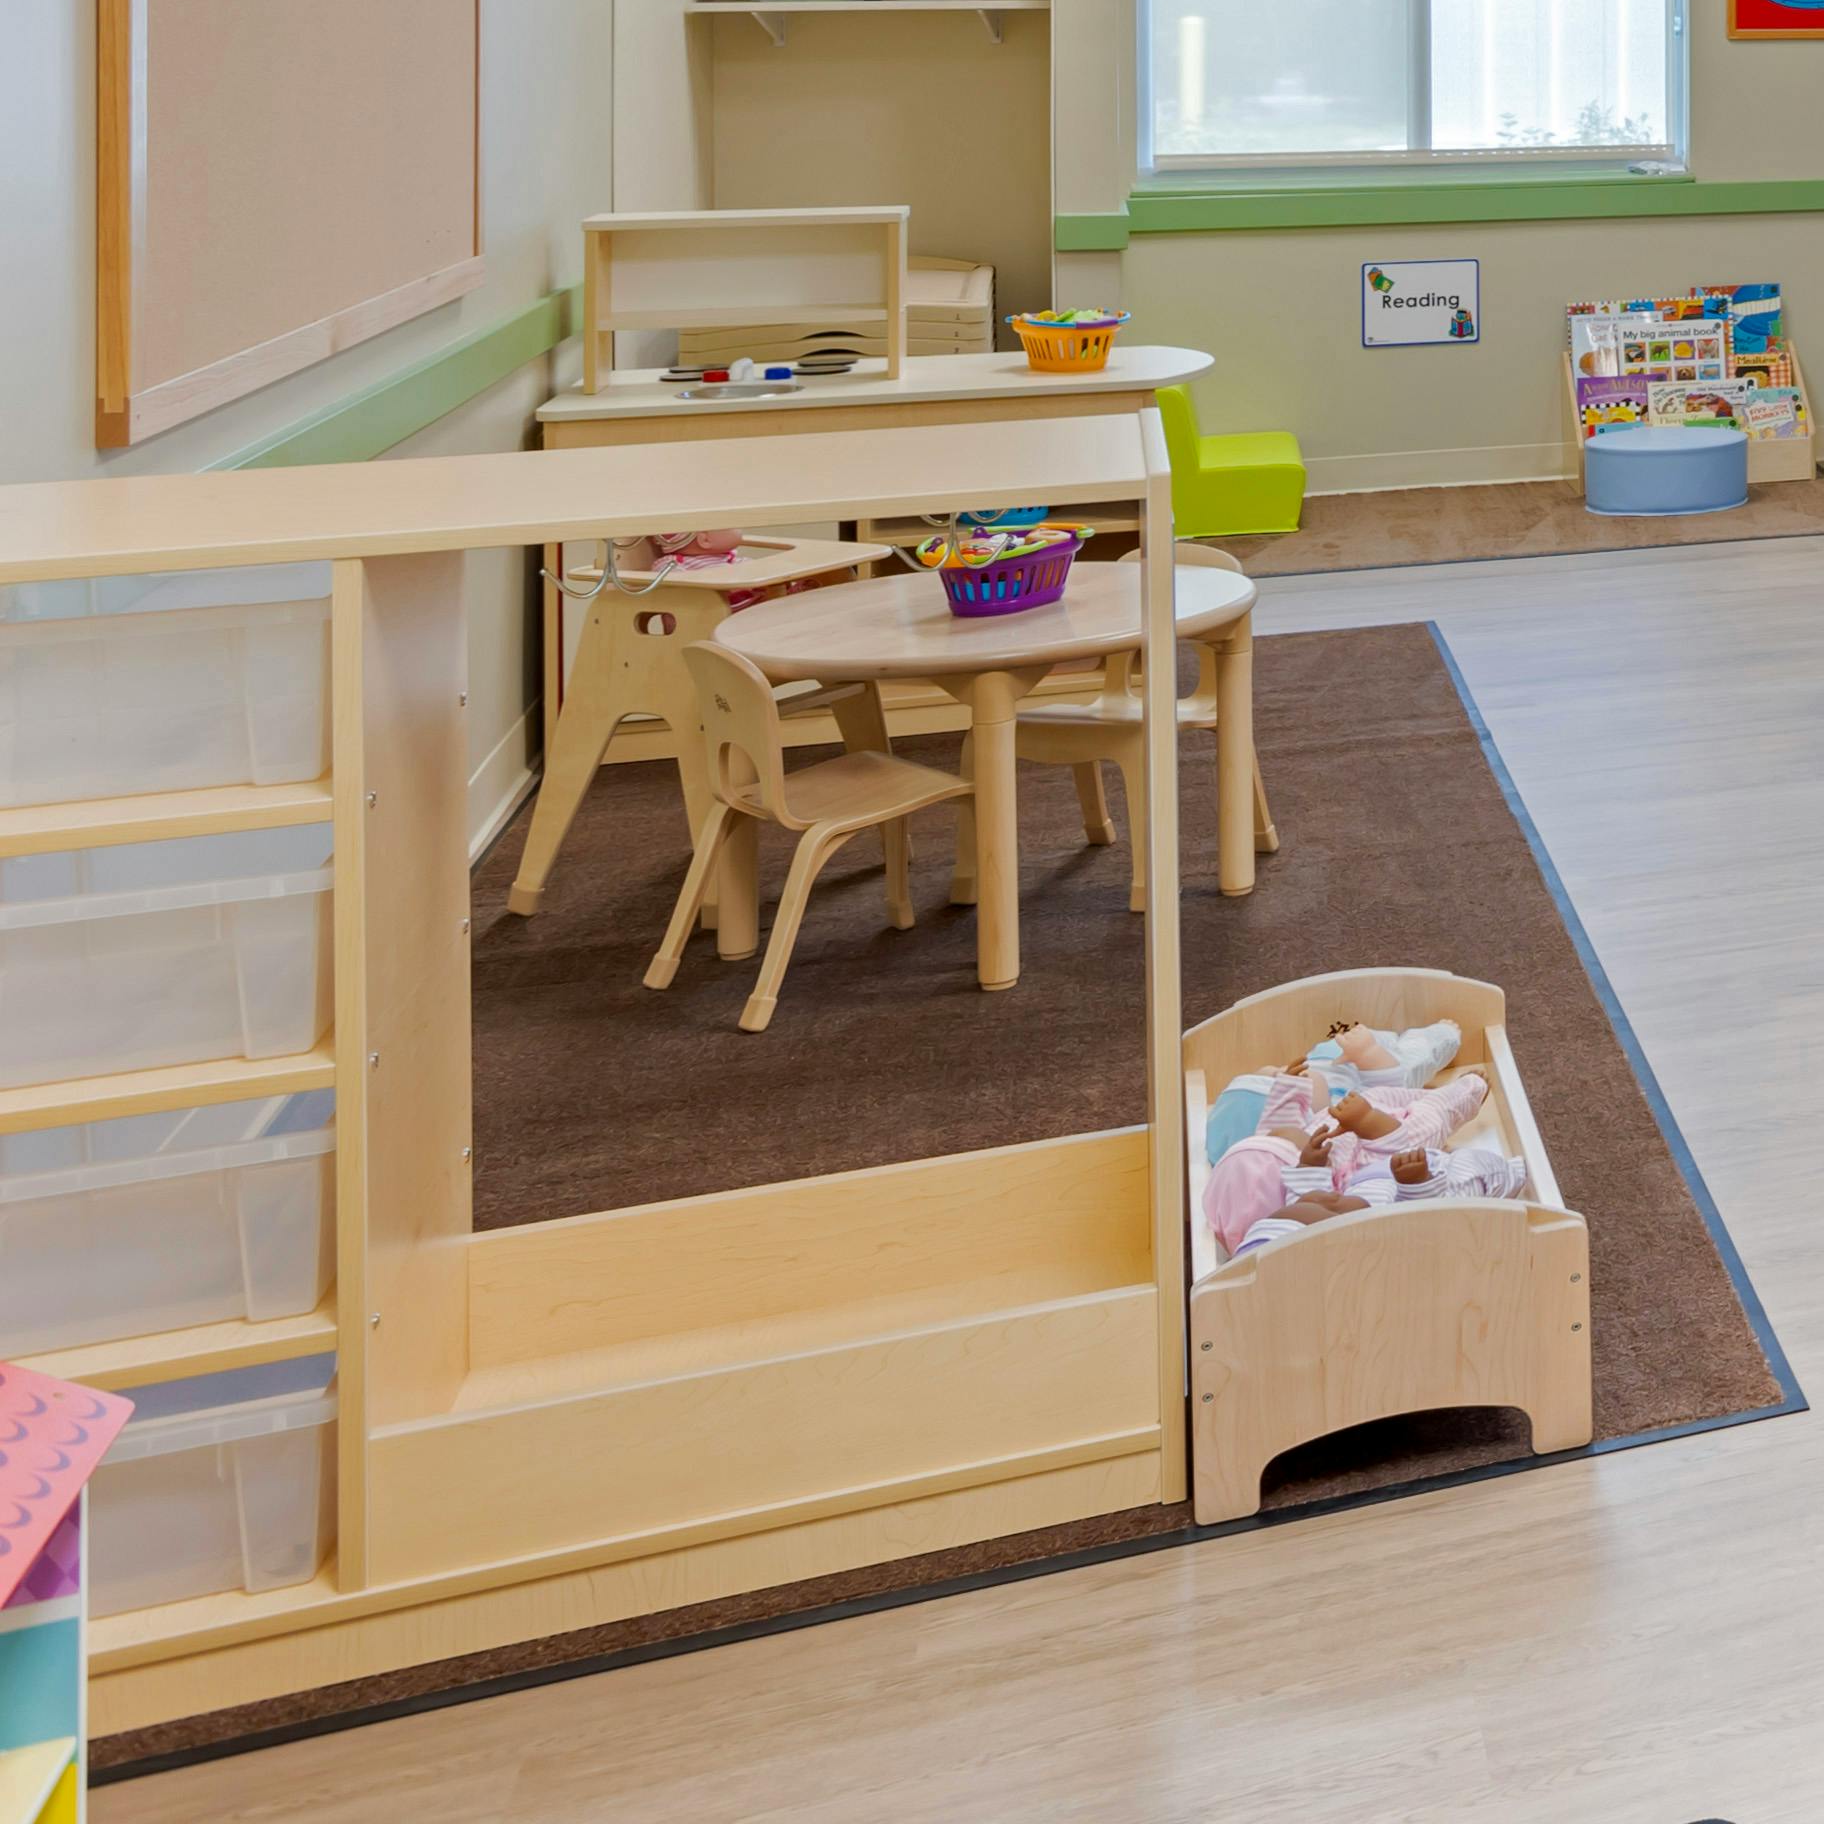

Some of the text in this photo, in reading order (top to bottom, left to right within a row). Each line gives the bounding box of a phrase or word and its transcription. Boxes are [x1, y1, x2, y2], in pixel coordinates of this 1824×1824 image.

[1382, 292, 1460, 310] Reading
[1623, 330, 1638, 340] My
[1640, 329, 1656, 339] big
[1658, 328, 1691, 337] animal
[1693, 327, 1718, 337] book
